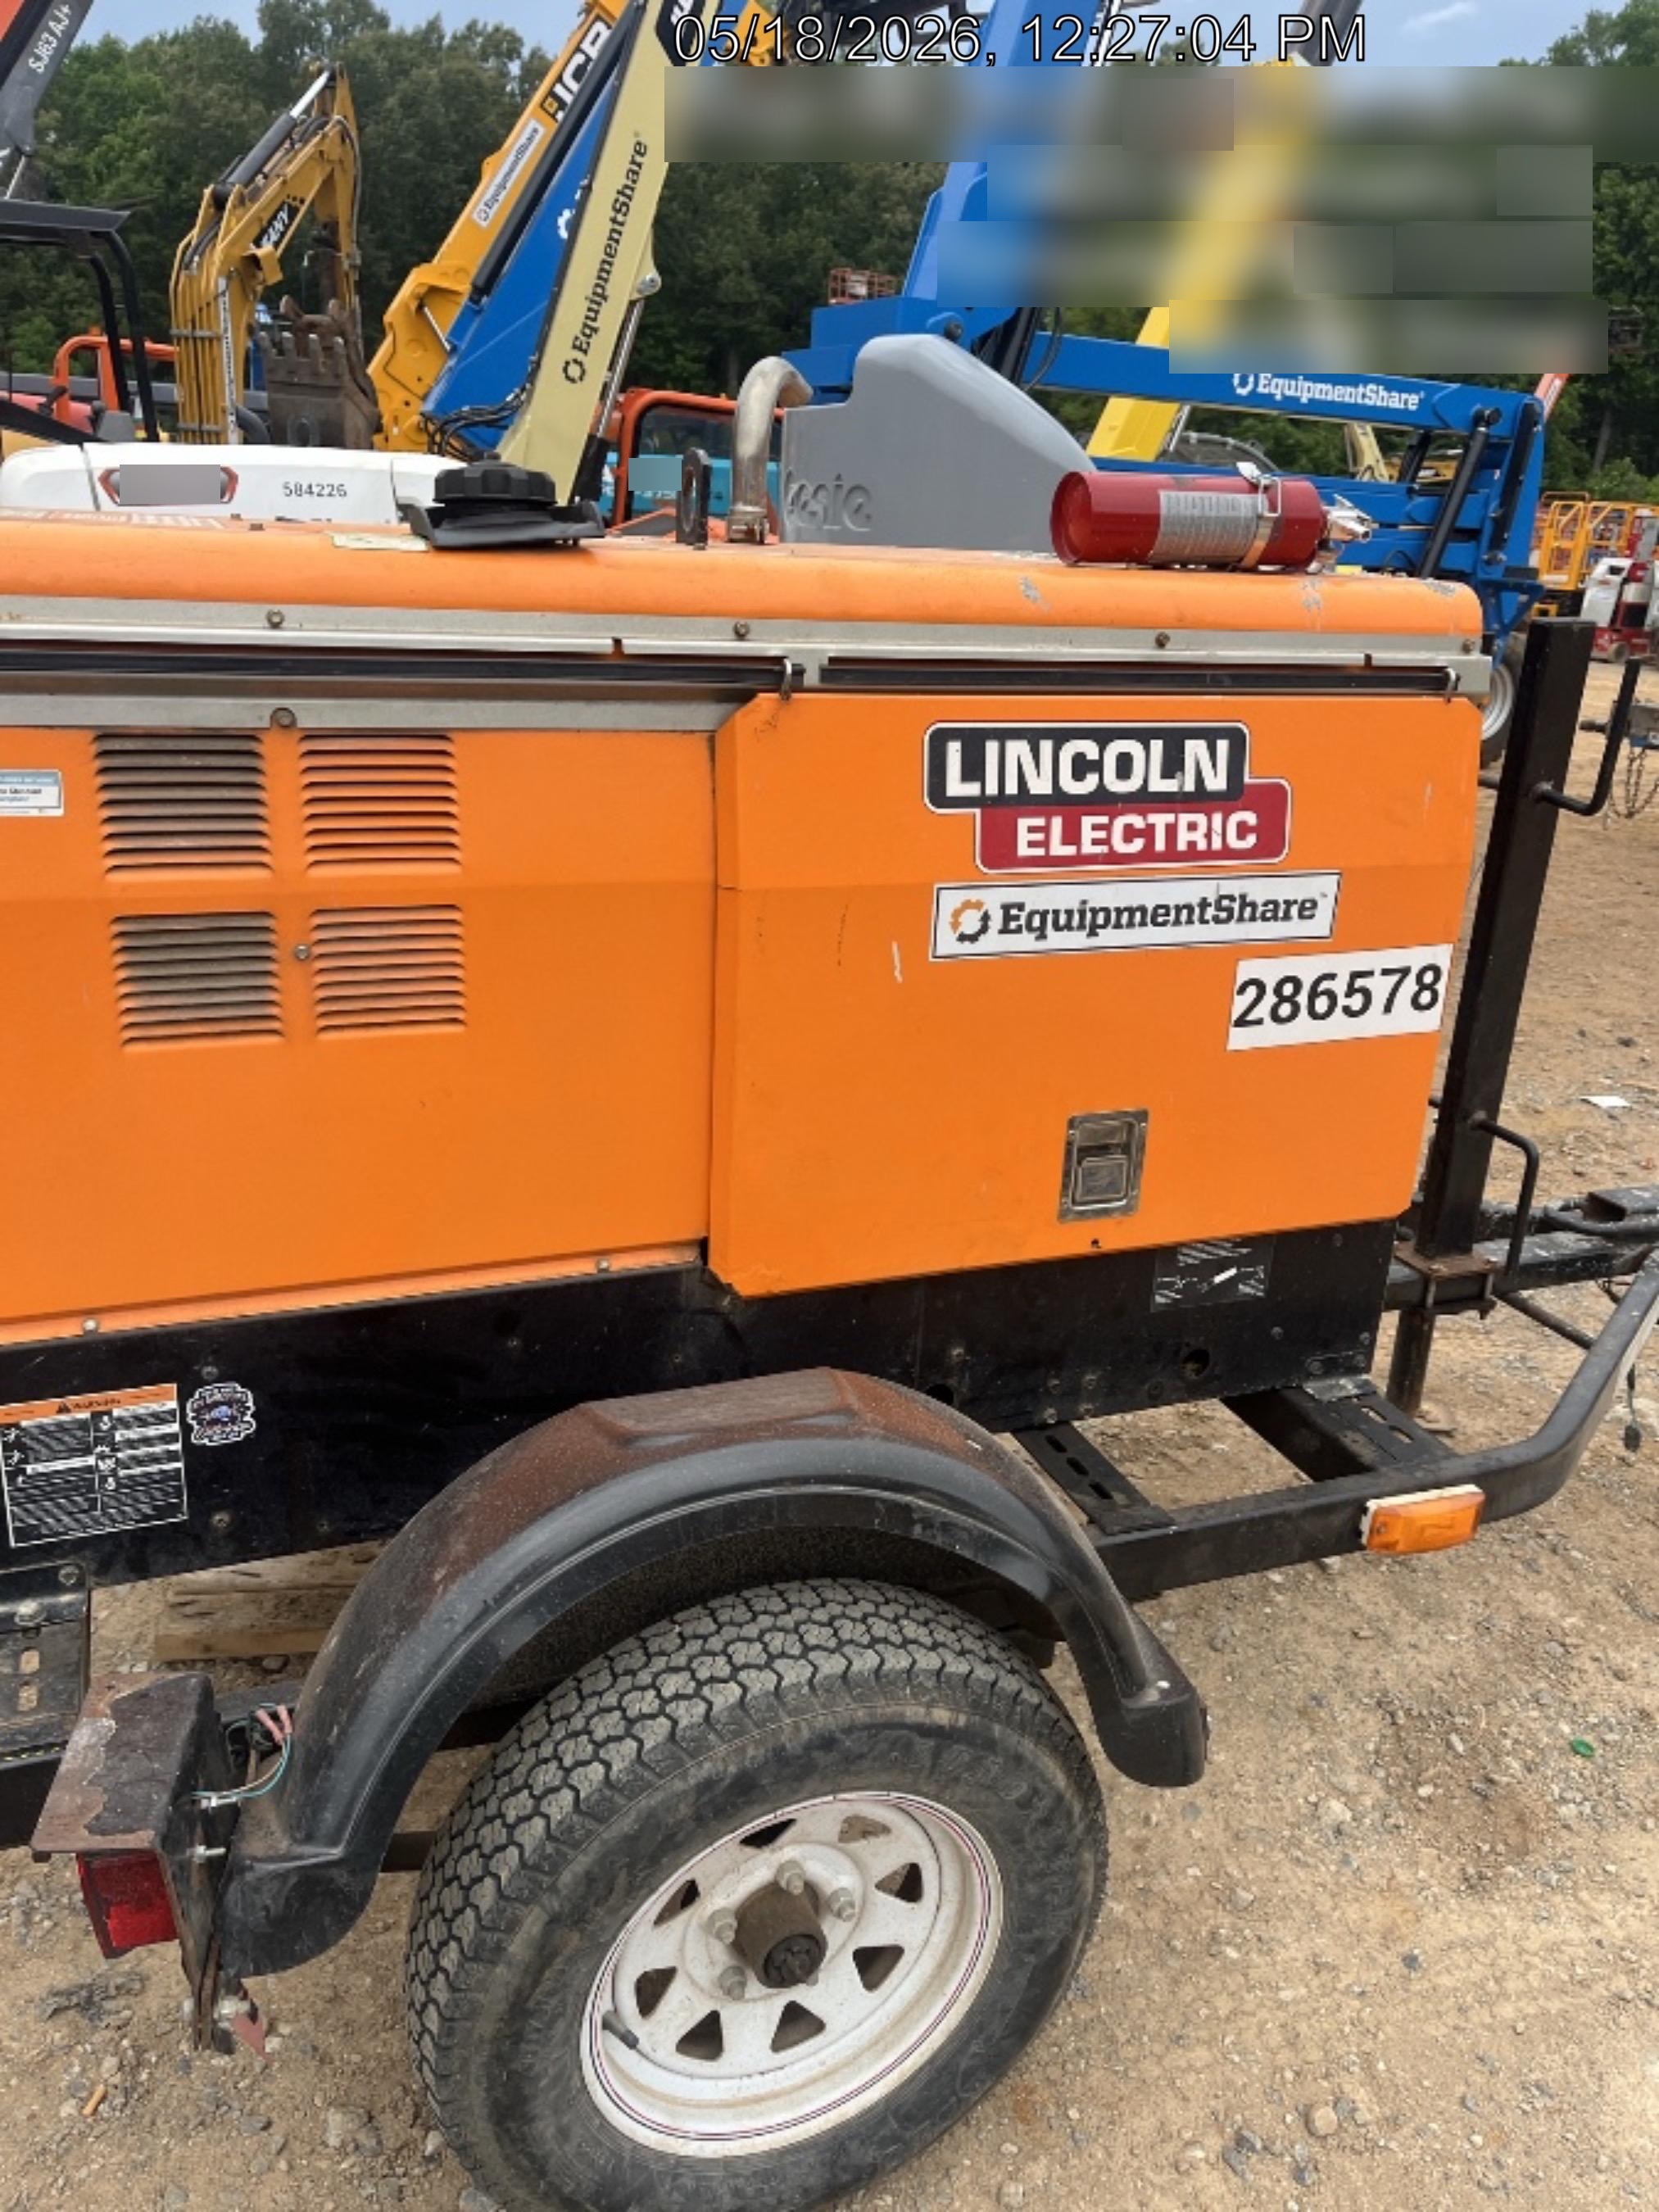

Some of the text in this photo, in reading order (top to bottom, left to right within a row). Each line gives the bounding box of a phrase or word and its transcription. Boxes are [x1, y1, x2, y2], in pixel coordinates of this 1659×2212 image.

[572, 140, 647, 357] EquipmentShare
[1256, 374, 1420, 411] EquipmentShare
[945, 739, 1229, 797] LINCOLN
[1017, 811, 1258, 857] ELECTRIC
[998, 891, 1320, 941] EquipmentShare
[1232, 963, 1442, 1027] 286578
